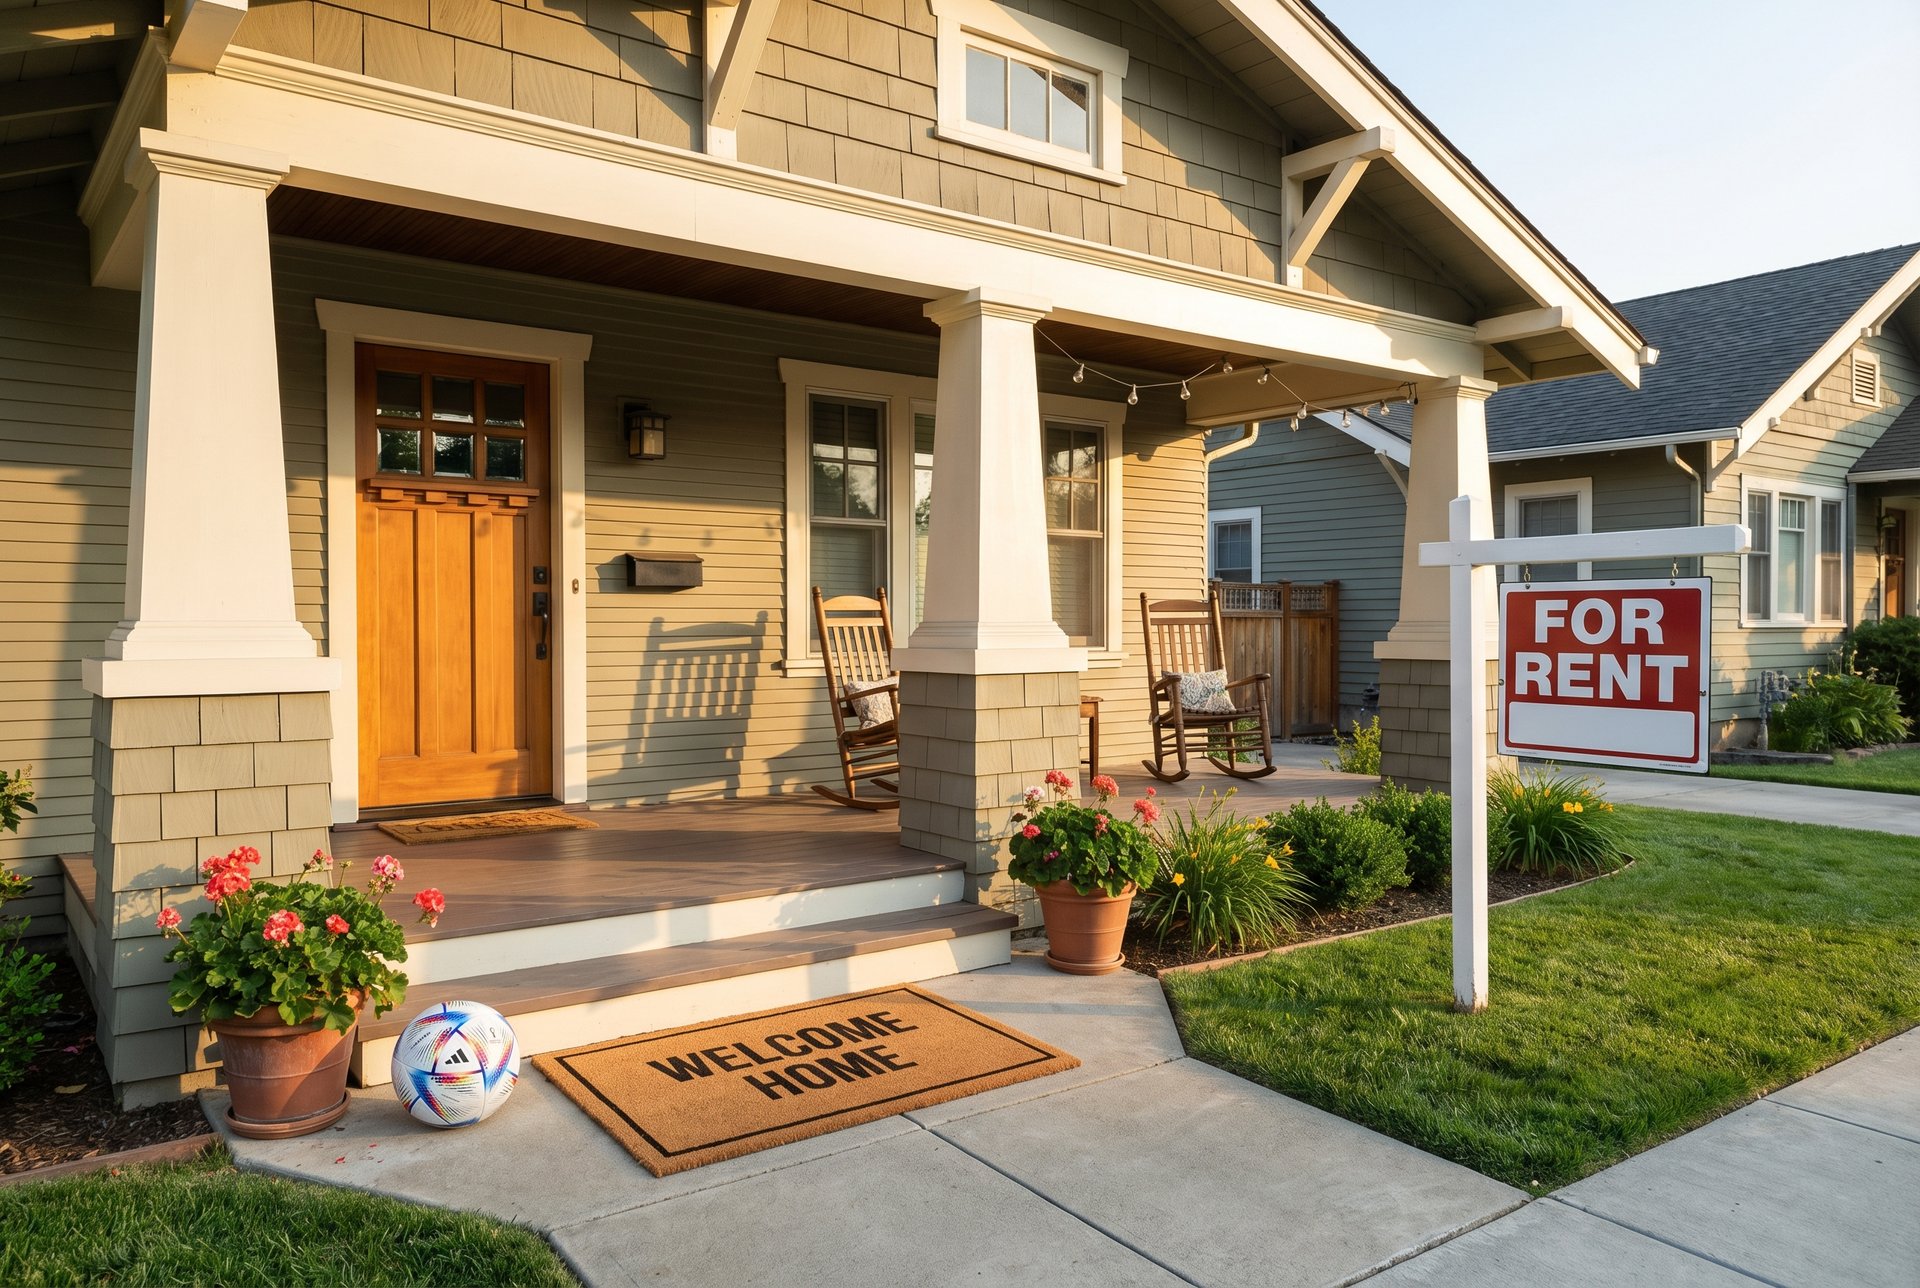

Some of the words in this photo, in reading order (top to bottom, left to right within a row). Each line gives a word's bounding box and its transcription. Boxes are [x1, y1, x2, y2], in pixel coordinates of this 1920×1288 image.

[1535, 598, 1665, 645] FOR
[1514, 651, 1689, 703] RENT
[646, 1011, 919, 1083] WELCOME
[742, 1045, 919, 1101] HOME
